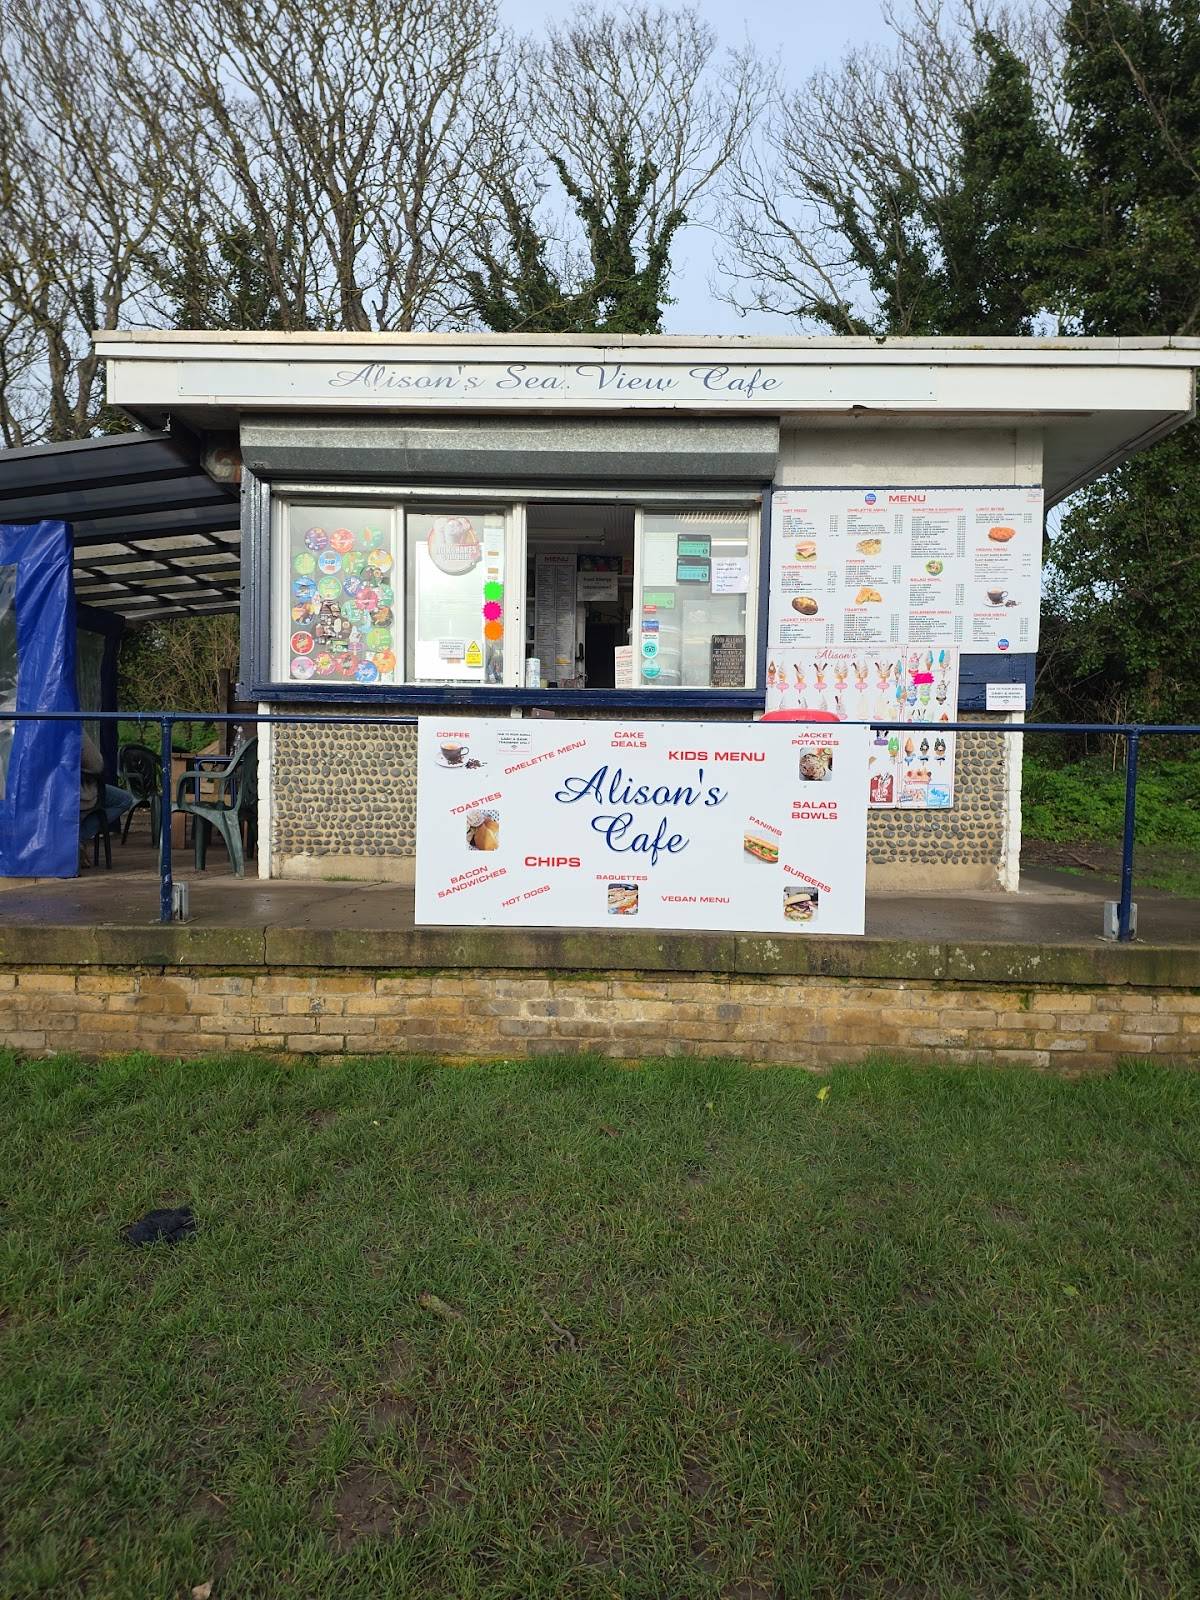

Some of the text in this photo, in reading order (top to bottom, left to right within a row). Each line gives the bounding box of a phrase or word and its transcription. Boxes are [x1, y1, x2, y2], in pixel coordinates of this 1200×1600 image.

[328, 362, 783, 398] Alison's Sea View Cafe
[888, 493, 926, 503] MENU
[815, 650, 857, 659] Alison's
[436, 731, 470, 739] COFFEE
[614, 731, 645, 739] CAKE
[798, 732, 833, 740] JACKET
[611, 740, 647, 748] DEALS
[504, 739, 588, 775] OMELETTE MENU
[668, 750, 766, 763] KIDS MENU
[554, 765, 728, 807] Alison's
[450, 791, 502, 815] TOASTIES
[792, 801, 838, 809] SALAD
[791, 811, 839, 820] BOWLS
[749, 815, 783, 836] PANINIS
[591, 812, 690, 867] Cafe
[524, 856, 582, 868] CHIPS
[450, 865, 489, 884] BACON
[783, 864, 832, 894] BURGERS
[437, 867, 508, 898] SANDWICHES
[502, 885, 551, 908] HOT DOGS
[661, 895, 731, 904] VEGAN MENU
